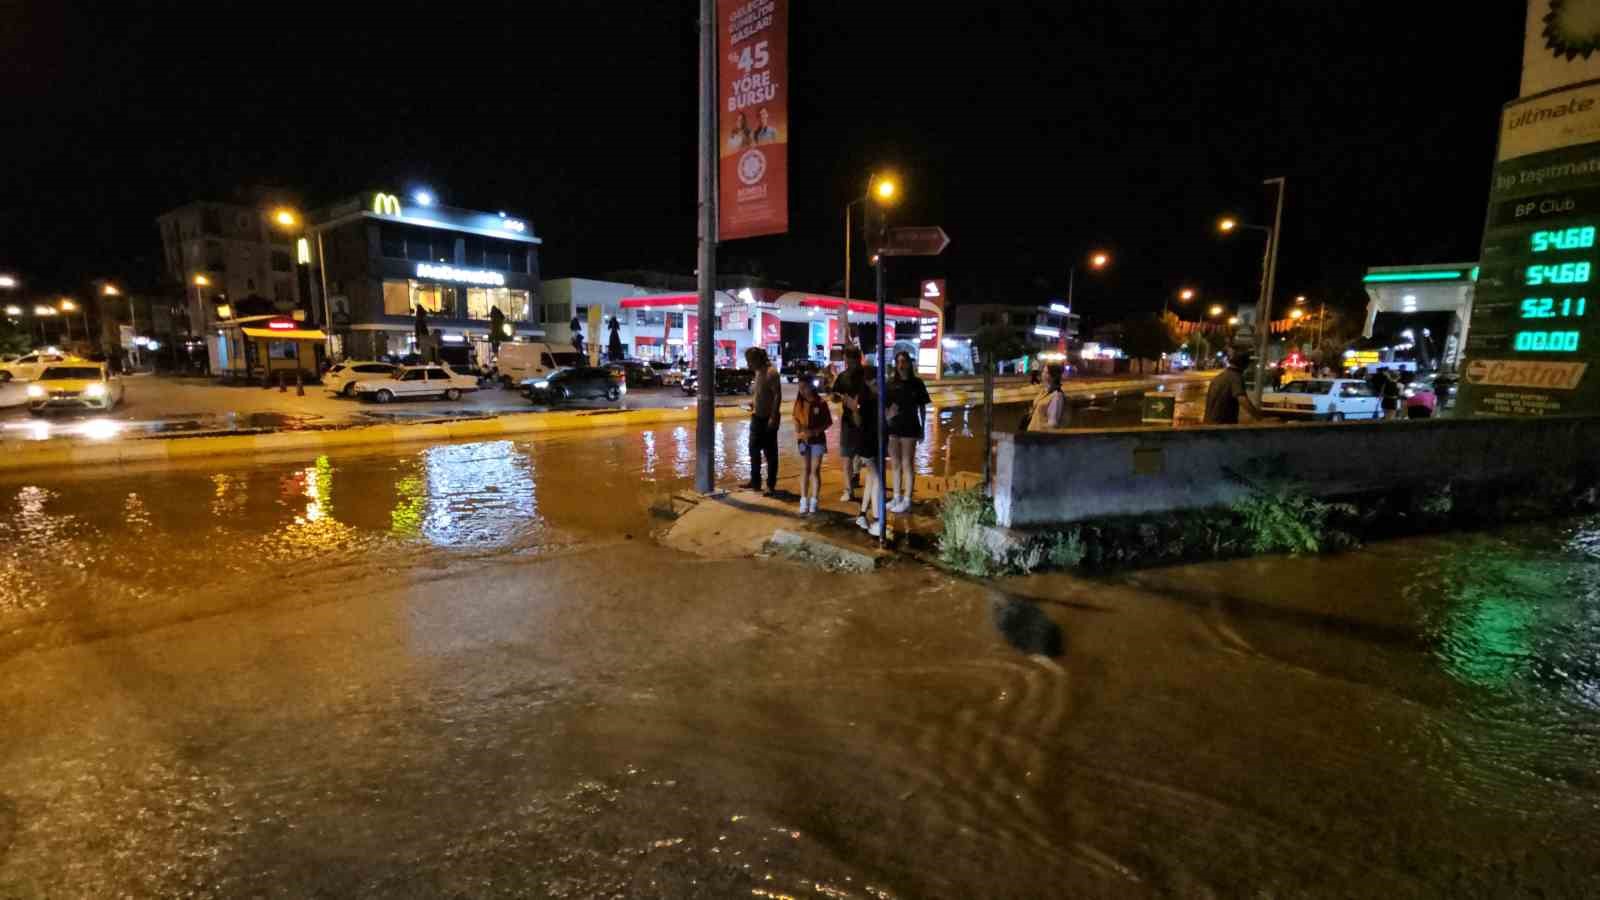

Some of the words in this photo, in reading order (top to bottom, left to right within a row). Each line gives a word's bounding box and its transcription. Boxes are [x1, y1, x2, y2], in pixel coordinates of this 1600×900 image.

[732, 71, 770, 95] YÖRE
[1509, 98, 1595, 130] ultimate
[1515, 201, 1536, 217] BP
[1540, 195, 1575, 214] Club
[1531, 226, 1595, 252] 54.68
[1526, 261, 1590, 286] 54.68
[1521, 297, 1586, 319] 52.11
[1488, 361, 1580, 386] Castrol
